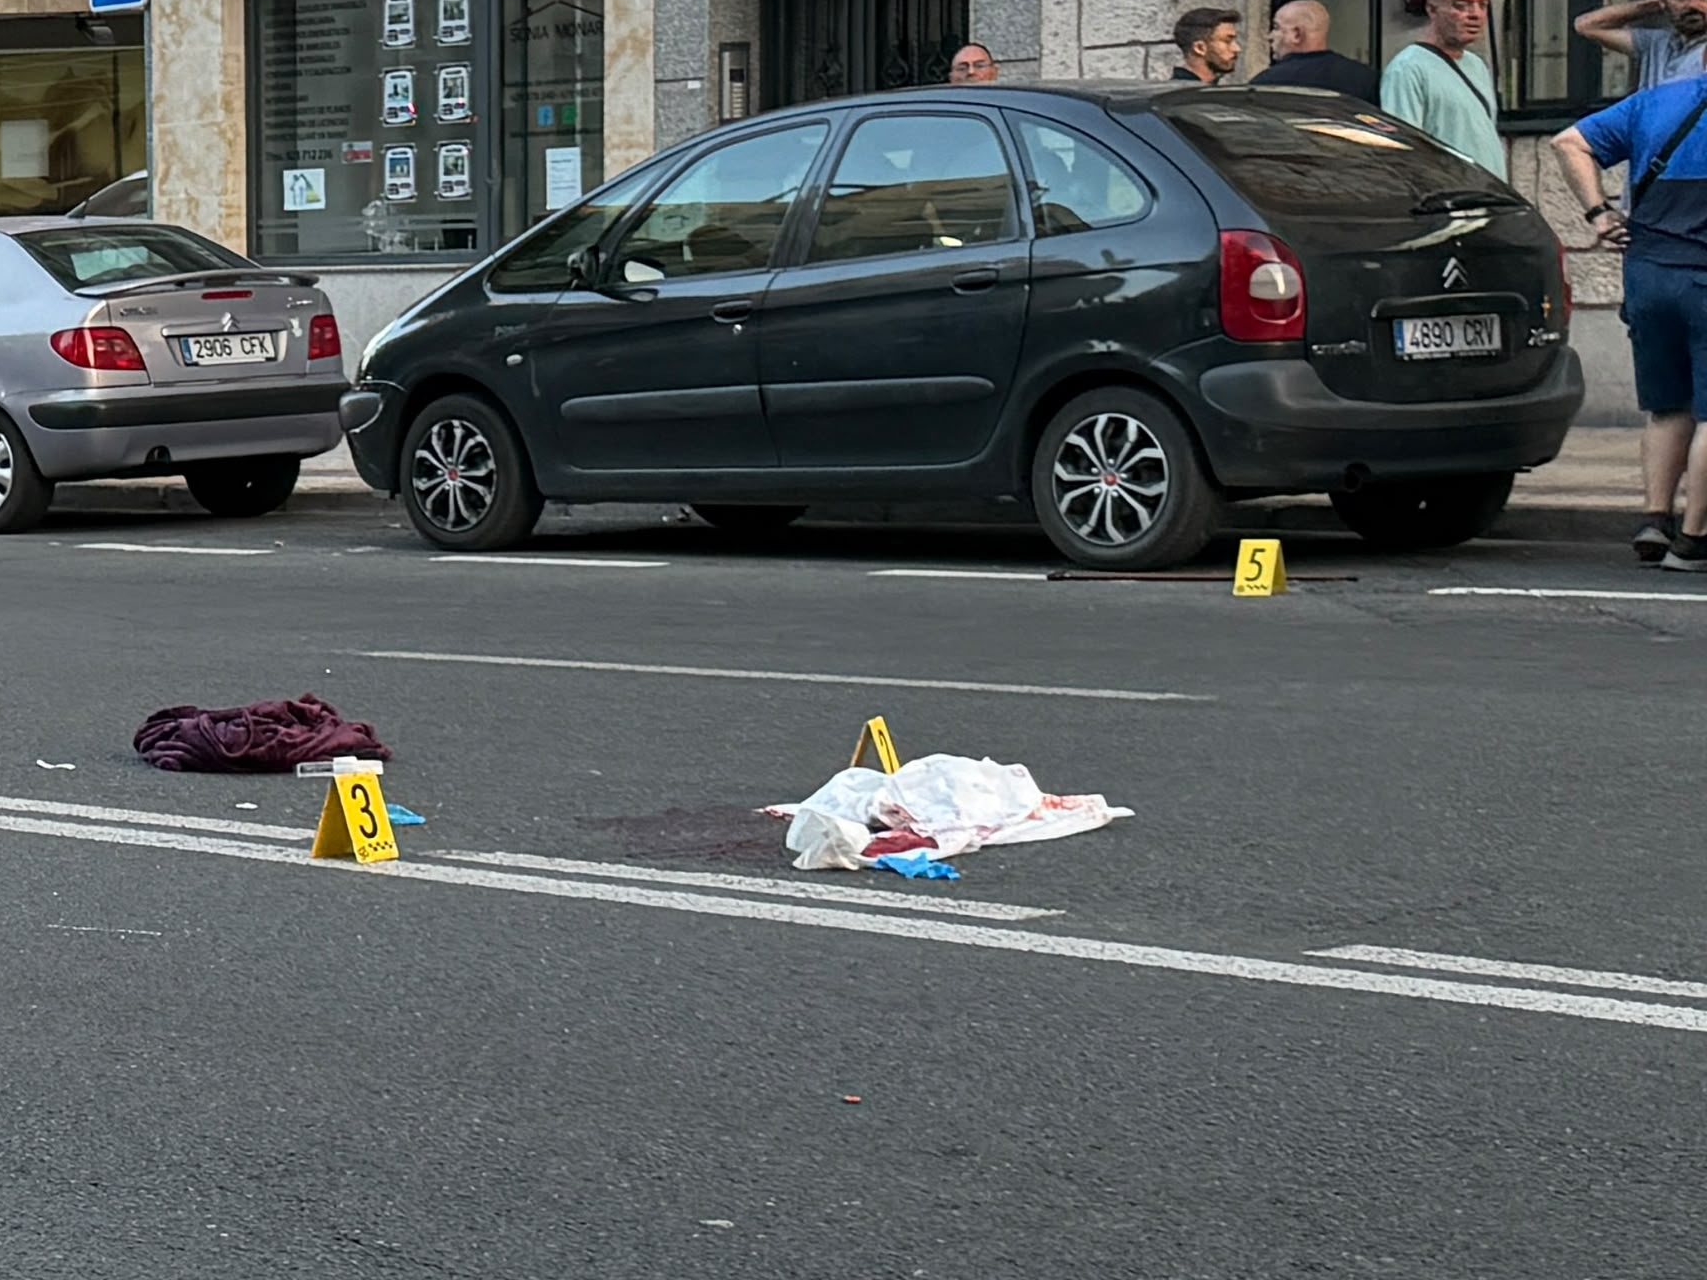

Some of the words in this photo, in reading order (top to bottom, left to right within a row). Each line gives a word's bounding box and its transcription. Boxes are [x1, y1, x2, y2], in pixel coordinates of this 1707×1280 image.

[193, 338, 233, 359] 2906
[240, 335, 269, 355] CFK
[1410, 321, 1454, 349] 4890
[1463, 318, 1495, 346] CRV
[1244, 548, 1266, 582] 5
[351, 783, 378, 839] 3
